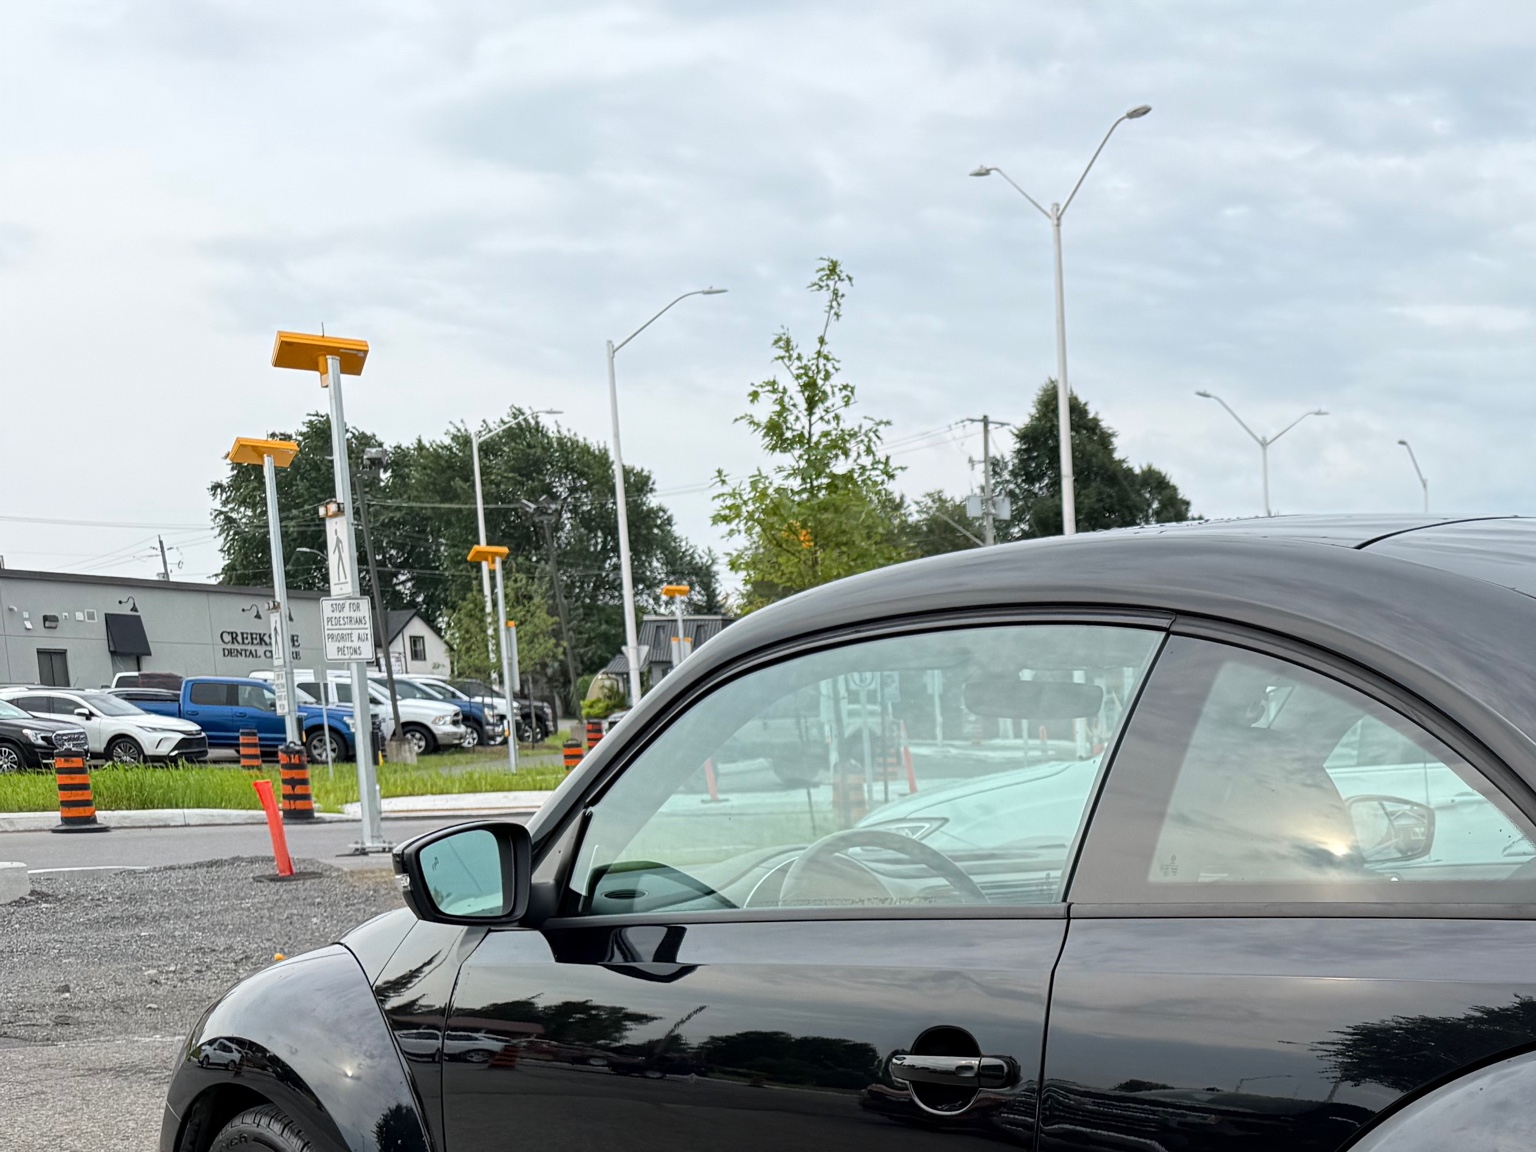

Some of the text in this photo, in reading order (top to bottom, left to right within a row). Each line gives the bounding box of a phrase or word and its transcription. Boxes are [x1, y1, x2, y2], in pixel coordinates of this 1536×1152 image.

[331, 602, 361, 613] STOP FOR
[326, 615, 367, 627] PEDESTRIANS
[220, 630, 300, 648] CREEKE
[357, 632, 369, 642] AUX
[222, 647, 261, 659] DENTAL
